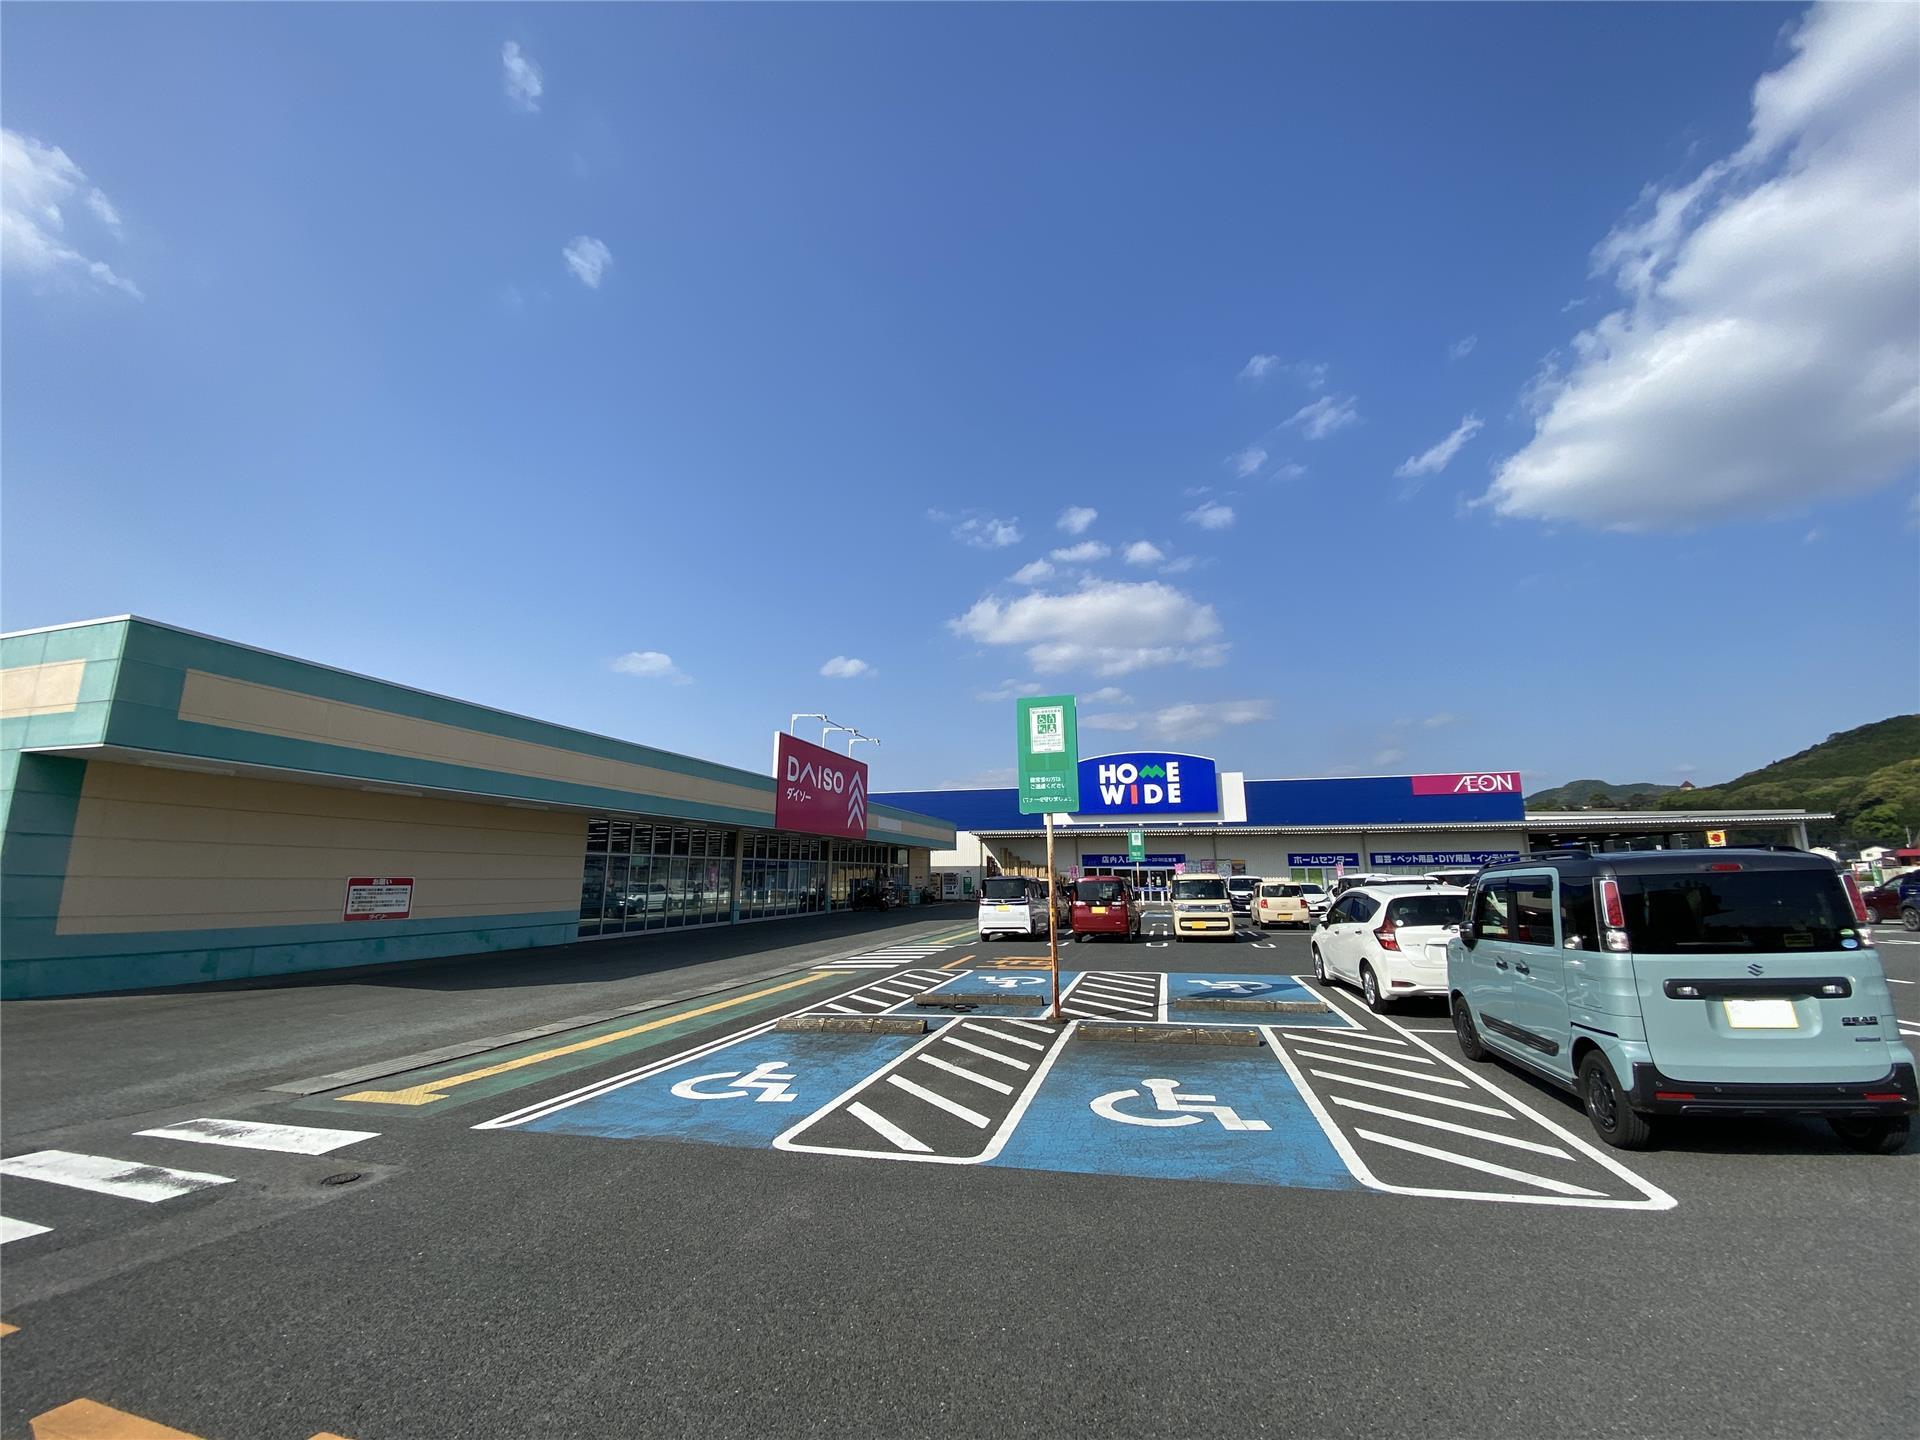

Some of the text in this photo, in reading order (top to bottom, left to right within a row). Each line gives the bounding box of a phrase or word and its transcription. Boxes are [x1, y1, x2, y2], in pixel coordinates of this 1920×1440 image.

[787, 755, 844, 794] DAISO
[1098, 761, 1180, 785] HOME
[786, 787, 812, 802] ダイソー
[1099, 783, 1181, 805] WIDE
[1293, 855, 1353, 864] ホームセンター
